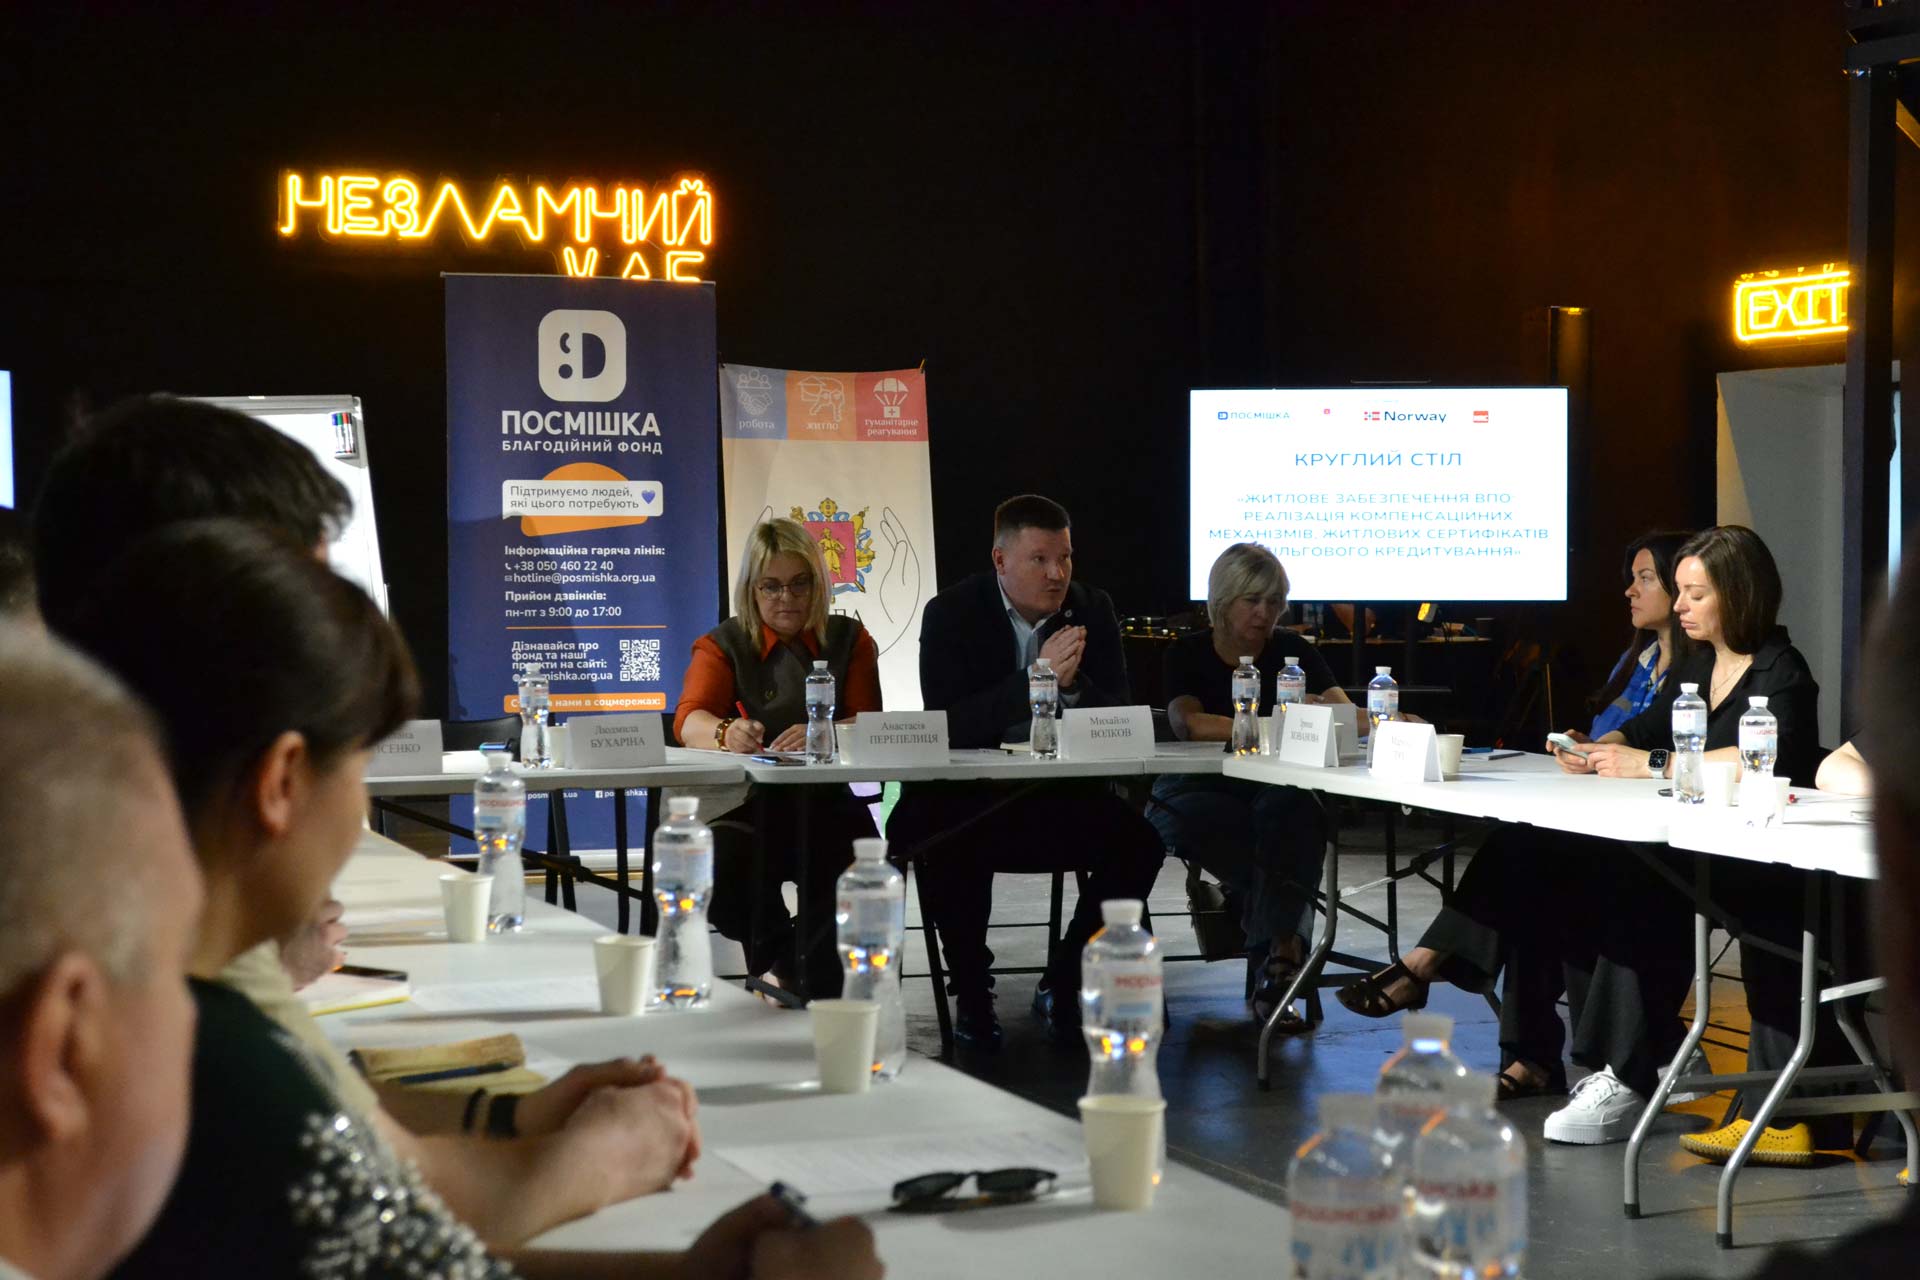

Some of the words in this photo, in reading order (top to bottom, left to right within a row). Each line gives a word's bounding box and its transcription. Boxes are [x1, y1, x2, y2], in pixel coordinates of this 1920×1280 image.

[279, 173, 713, 246] НЕЗЛАМНИЙ
[1748, 281, 1850, 330] EXIT
[1230, 411, 1290, 420] ПОСМІШКА
[1383, 410, 1447, 424] Norway
[501, 410, 661, 436] ПОСМІШКА
[502, 439, 612, 454] БЛАГОДІЙНИЙ
[618, 441, 663, 454] ФОНД
[1295, 450, 1402, 466] КРУГЛИЙ
[1410, 453, 1462, 466] СТІЛ
[510, 486, 589, 499] Підтримуємо
[591, 486, 633, 499] людей,
[1336, 493, 1469, 504] ЗАБЕЗПЕЧЕННЯ
[510, 499, 528, 509] які
[531, 499, 565, 510] цього
[568, 499, 639, 512] потребують
[1244, 511, 1345, 522] РЕАЛІЗАЦІЯ
[1323, 529, 1421, 539] ЖИТЛОВИХ
[1427, 529, 1549, 539] СЕРТИФІКАТІВ
[504, 545, 588, 557] Інформаційна
[591, 547, 631, 557] гаряча
[634, 545, 665, 556] лінія:
[513, 561, 533, 571] +38
[536, 561, 557, 571] 050
[560, 561, 580, 571] 460
[583, 561, 598, 571] 22
[600, 561, 614, 571] 40
[513, 573, 656, 585] hotline@posmishka.org.ua
[505, 590, 552, 602] Прийом
[554, 590, 607, 602] дзвінків:
[505, 607, 537, 618] пн-пт
[540, 608, 546, 618] з
[548, 607, 573, 617] 9:00
[575, 608, 590, 619] до
[592, 606, 622, 617] 17:00
[511, 641, 575, 652] Дізнавайся
[578, 642, 599, 651] про
[511, 651, 543, 661] фонд
[546, 652, 558, 660] та
[560, 651, 587, 660] наші
[576, 660, 608, 670] сайті:
